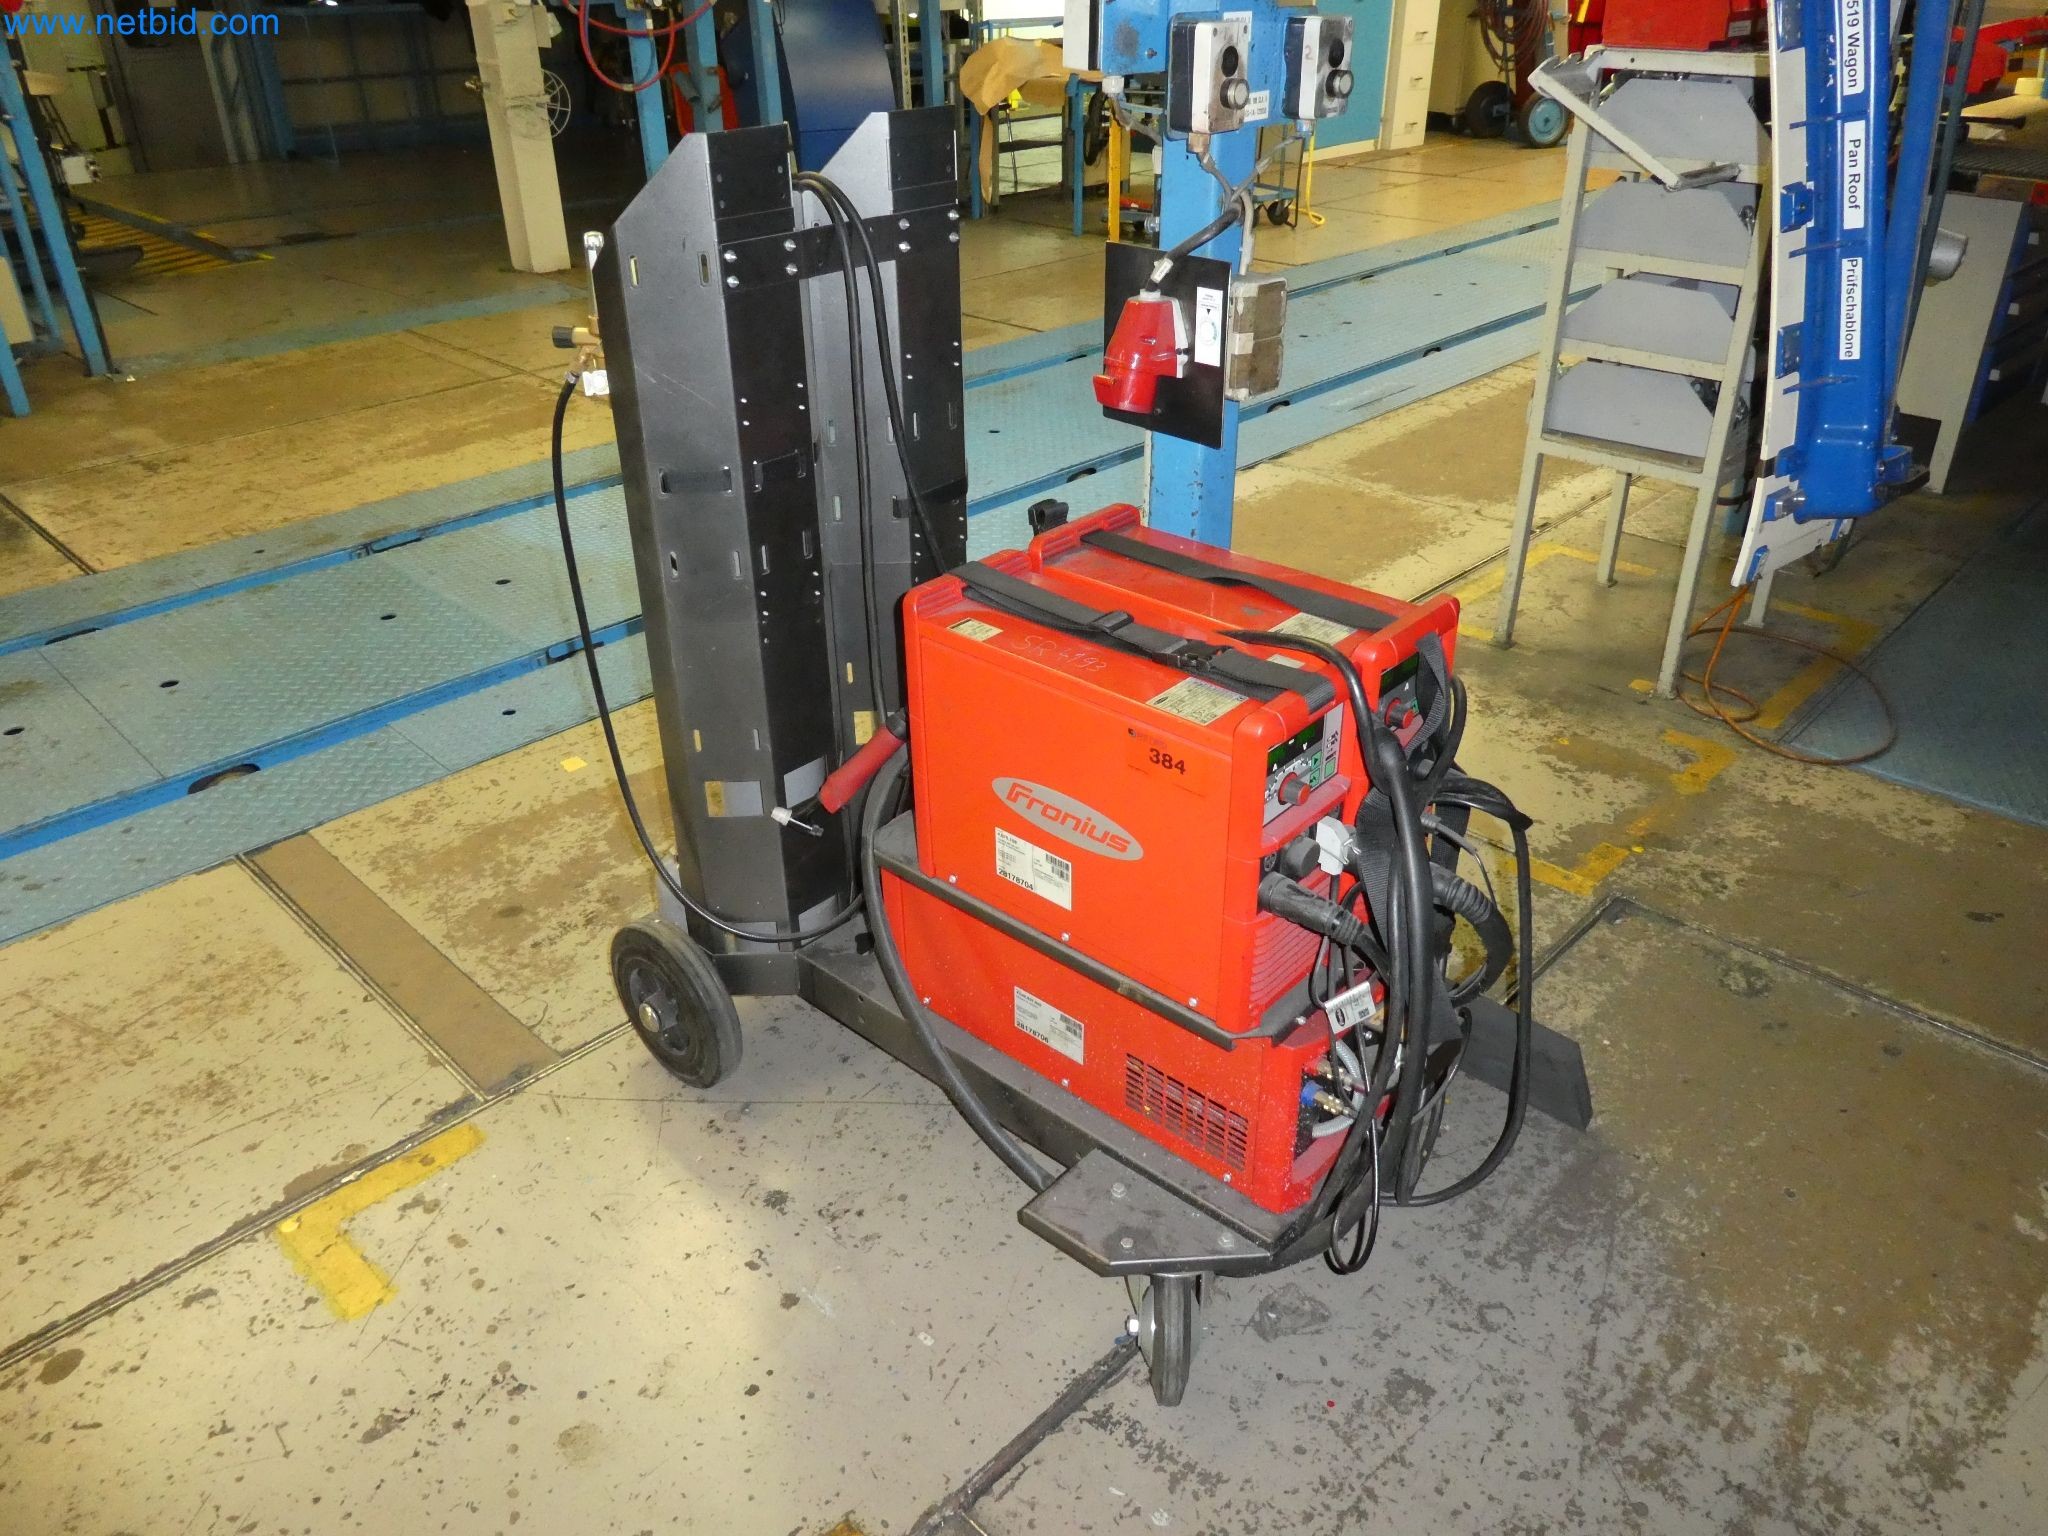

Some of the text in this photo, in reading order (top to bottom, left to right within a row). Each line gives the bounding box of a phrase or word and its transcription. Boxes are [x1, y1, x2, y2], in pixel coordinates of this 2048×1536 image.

[1844, 0, 1860, 88] 519 Wagon
[1848, 138, 1861, 210] Pan Roof
[1844, 259, 1858, 358] Prüfschablone
[1149, 747, 1186, 775] 384
[1006, 782, 1132, 853] Fronius
